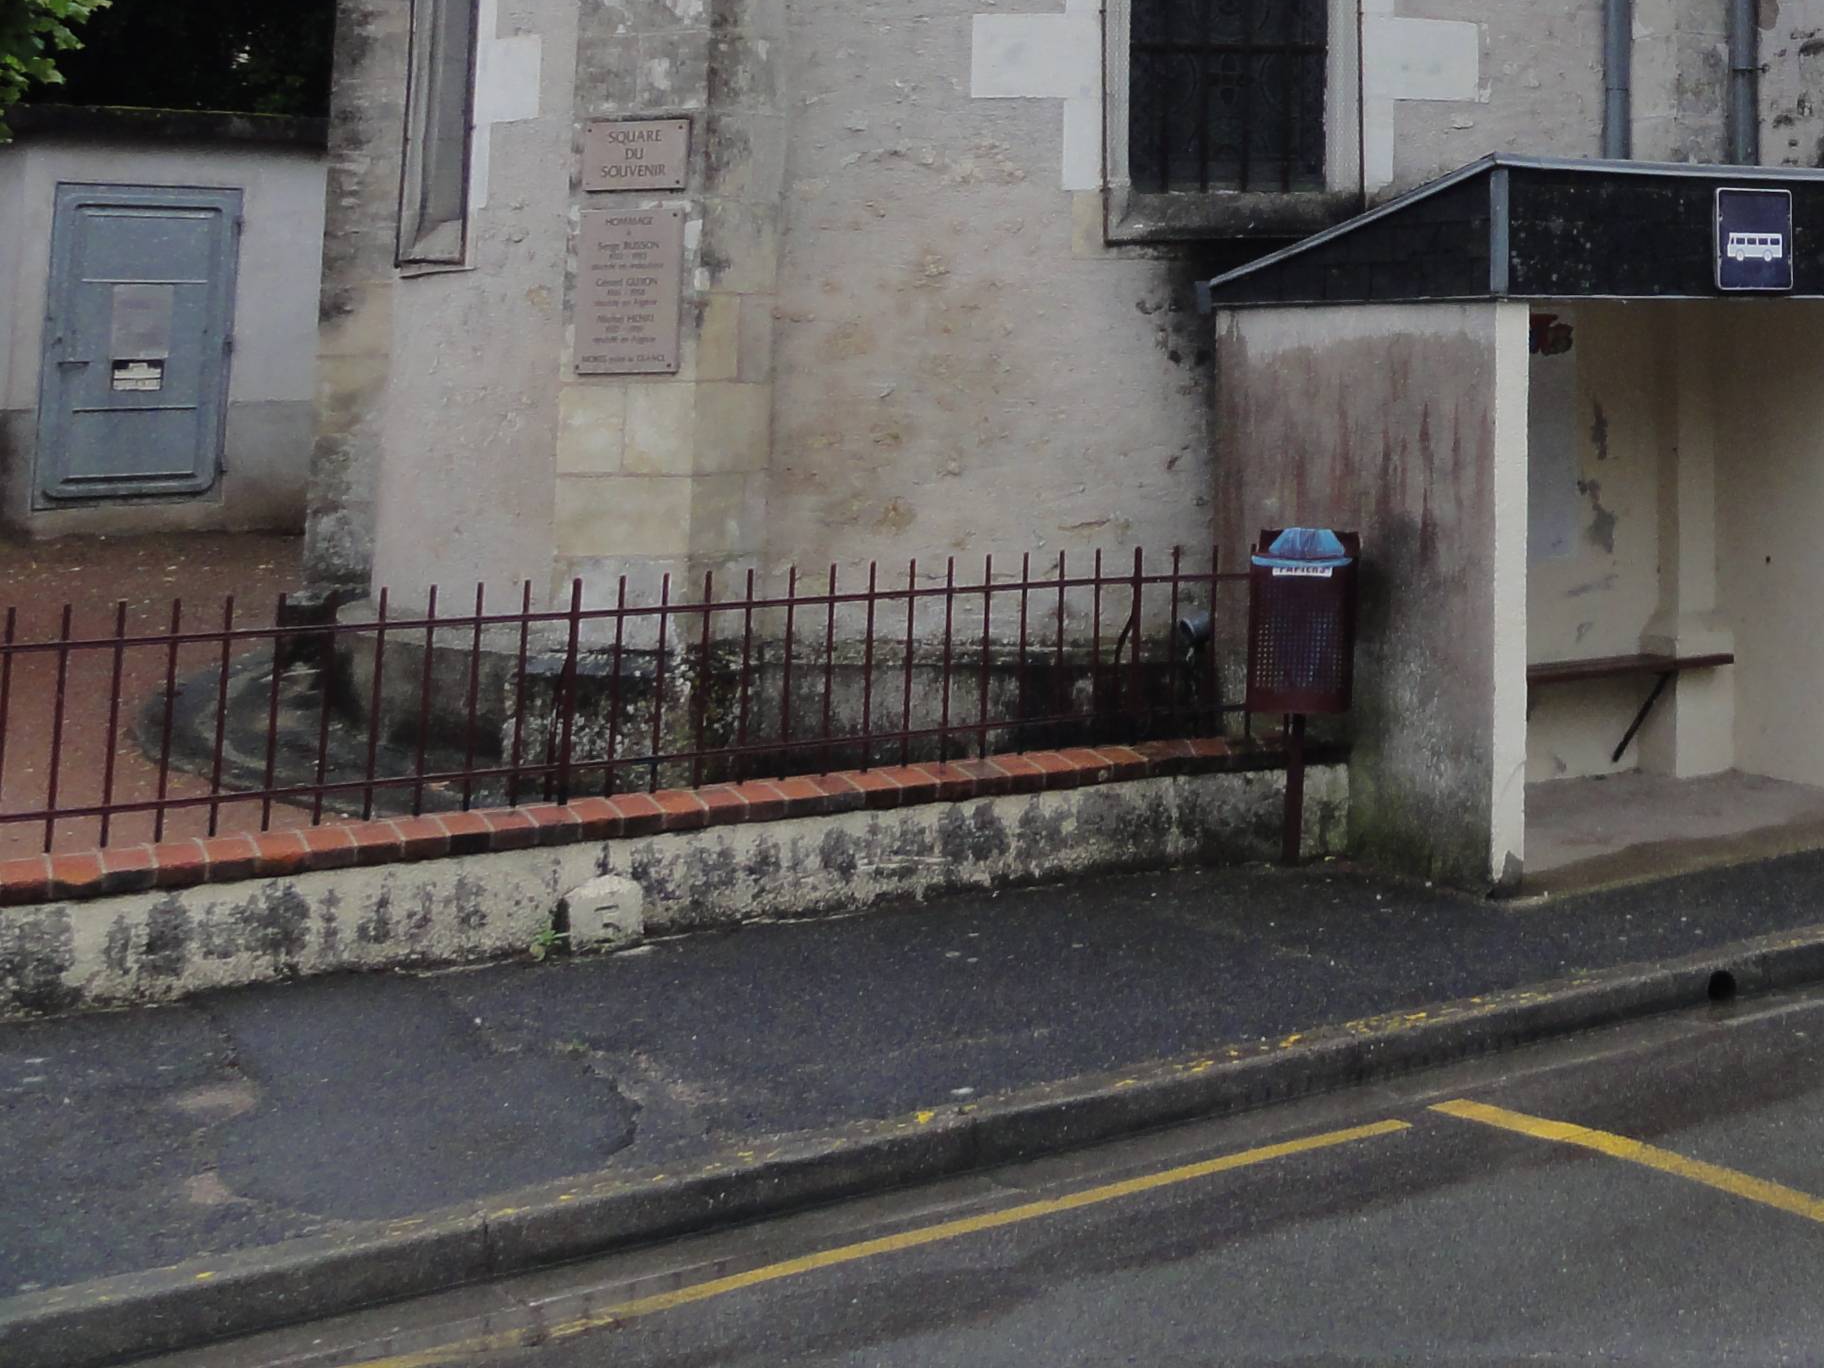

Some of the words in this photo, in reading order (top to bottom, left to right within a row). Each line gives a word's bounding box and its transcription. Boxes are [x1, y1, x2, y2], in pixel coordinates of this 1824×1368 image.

[608, 129, 662, 145] SQUARE
[625, 147, 644, 160] DU
[600, 164, 665, 178] SOUVENIR
[605, 216, 654, 226] HOMMAGE
